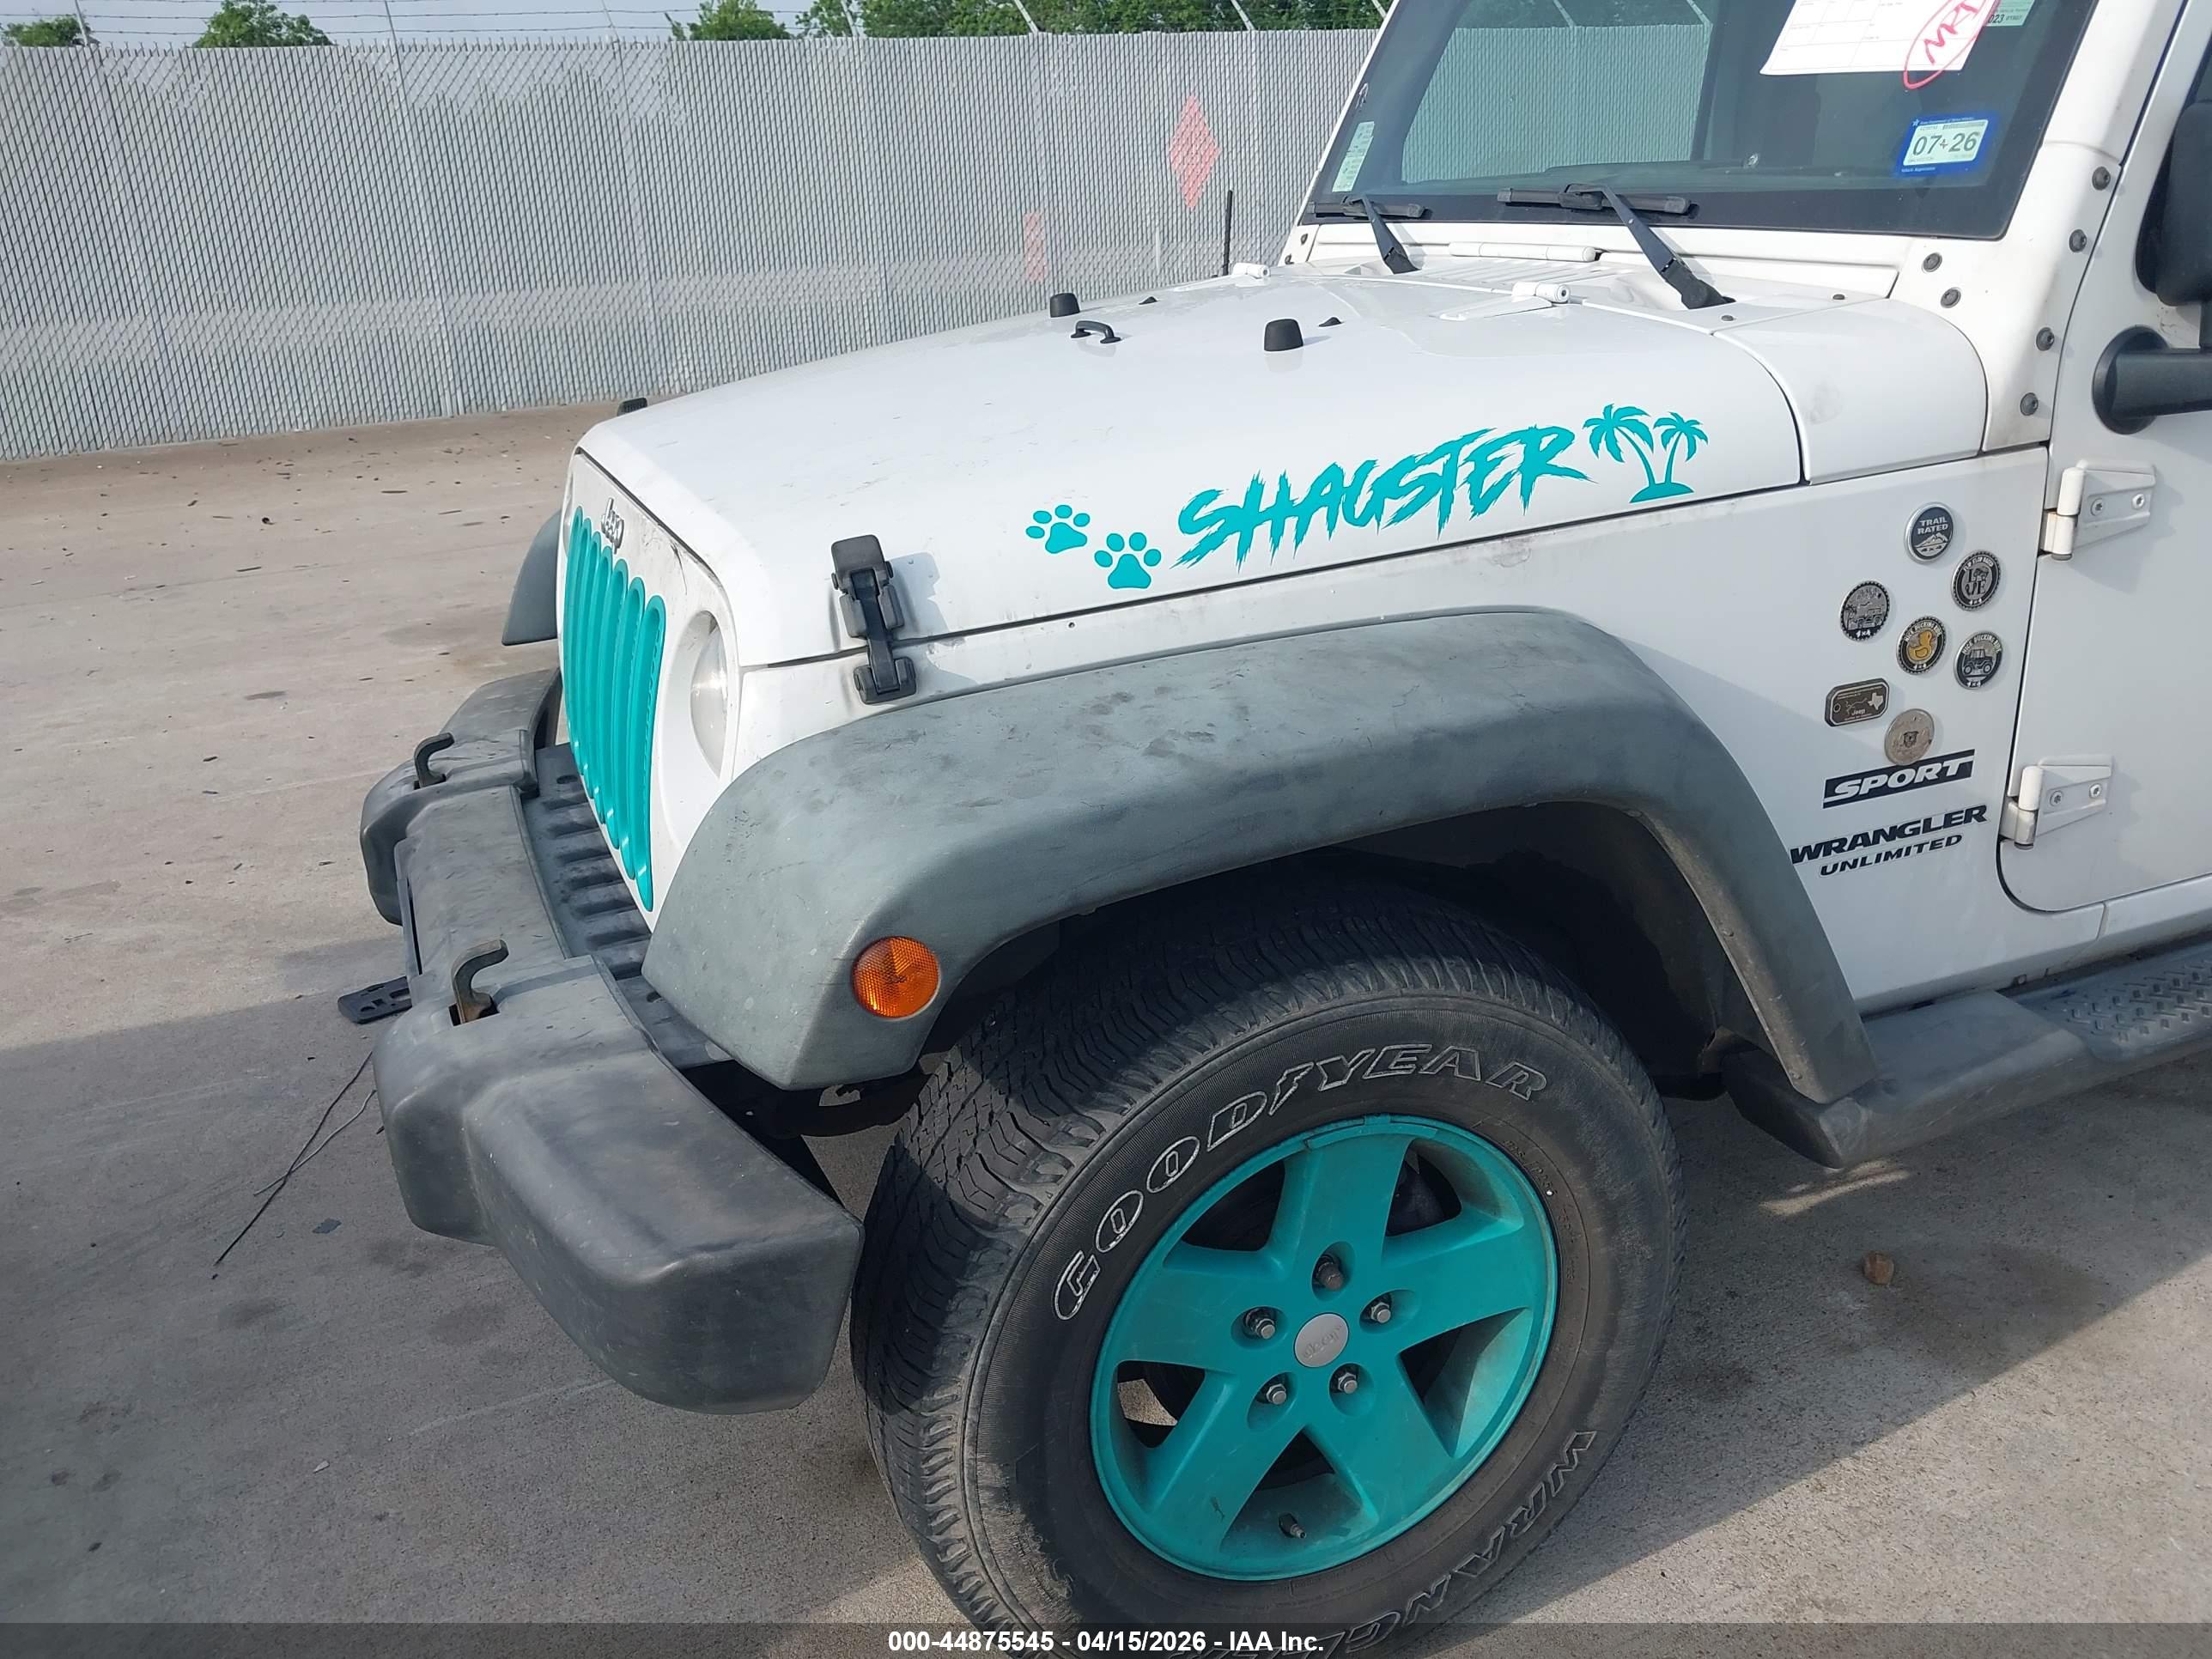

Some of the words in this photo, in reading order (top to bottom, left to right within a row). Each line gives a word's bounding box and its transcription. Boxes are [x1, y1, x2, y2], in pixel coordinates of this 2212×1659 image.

[1913, 135, 1942, 156] 07
[1948, 131, 1980, 153] 26
[1917, 523, 1948, 535] RATED
[1919, 516, 1948, 527] TRAIL
[1827, 756, 1974, 803] SPORT
[1790, 805, 1987, 865] WRANGLER
[1820, 834, 1963, 876] UNLIMITED
[1052, 1043, 1547, 1321] GOODYEAR
